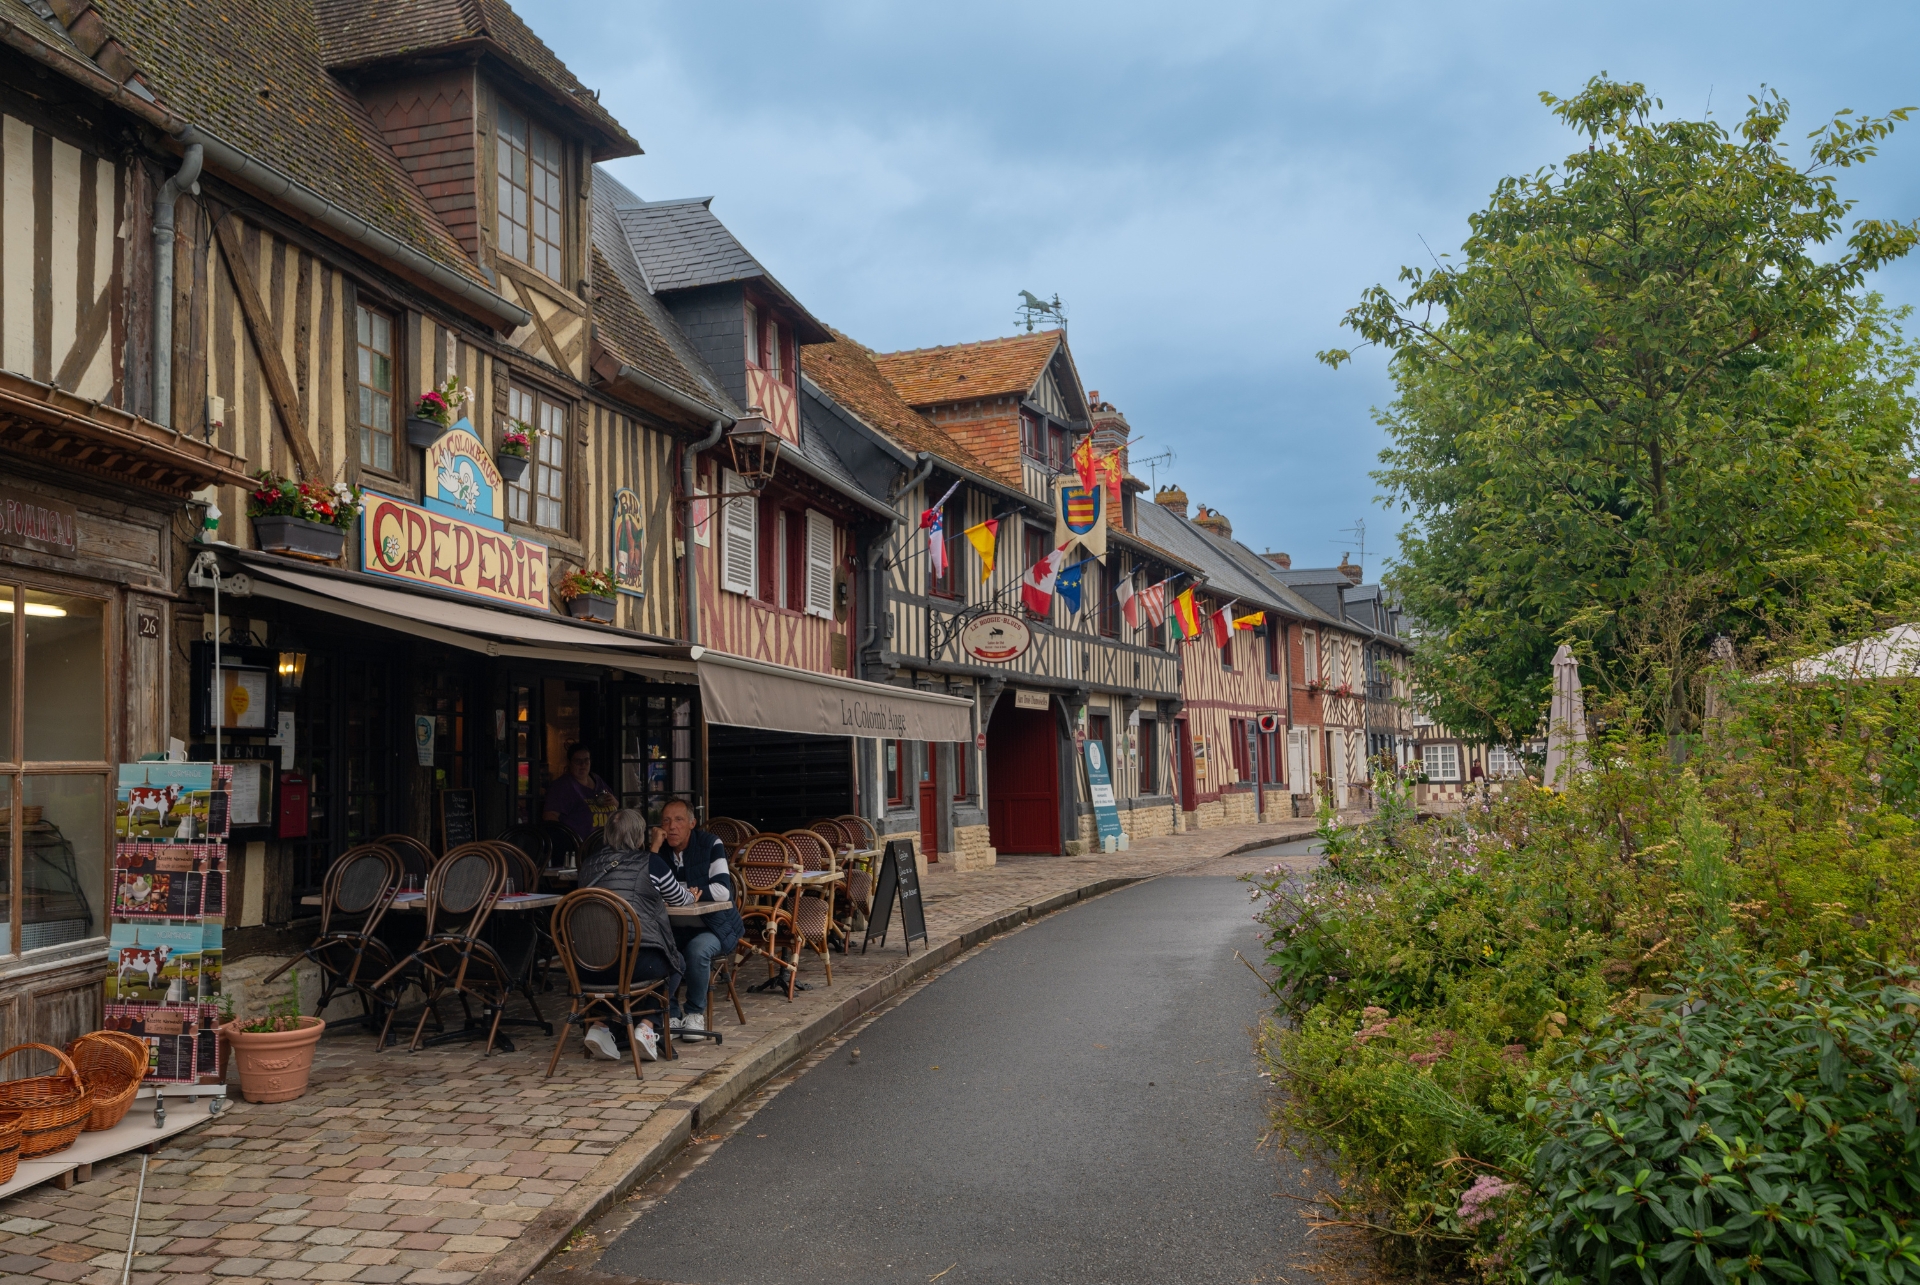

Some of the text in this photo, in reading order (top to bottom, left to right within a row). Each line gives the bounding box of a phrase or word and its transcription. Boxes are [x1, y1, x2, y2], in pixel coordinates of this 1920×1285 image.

[143, 617, 157, 635] 26
[969, 623, 979, 632] LE
[840, 698, 853, 727] La
[220, 746, 266, 758] MENU
[167, 768, 203, 779] NORMANDIE
[156, 930, 193, 941] NORMANDIE
